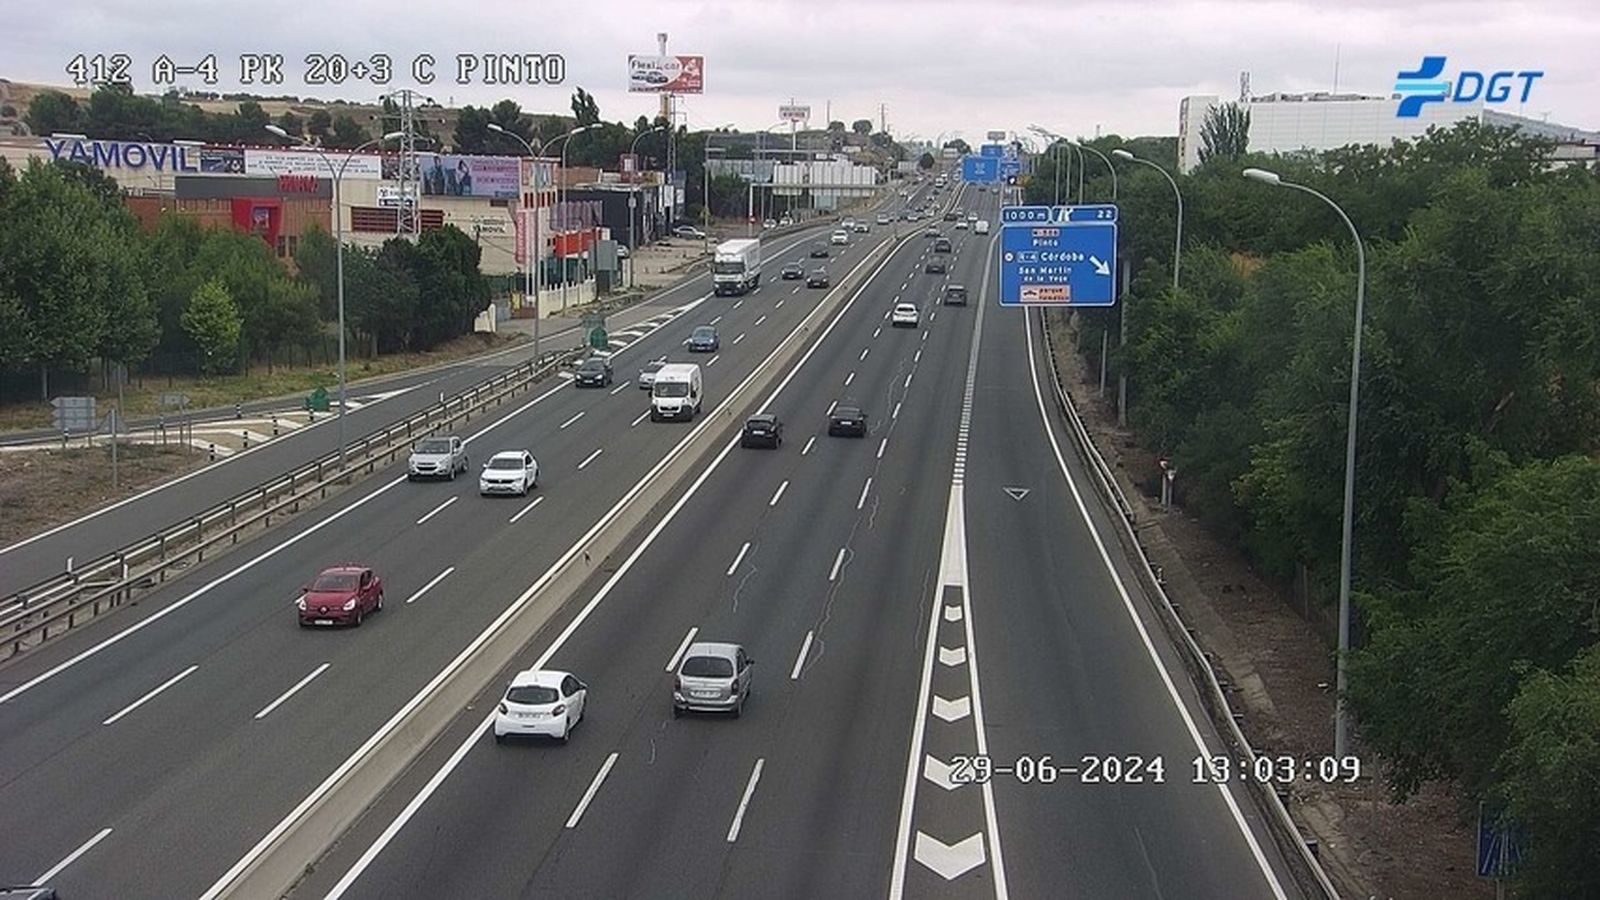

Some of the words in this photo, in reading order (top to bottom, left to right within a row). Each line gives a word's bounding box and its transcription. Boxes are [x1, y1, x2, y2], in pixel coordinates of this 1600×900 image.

[45, 139, 199, 173] YAMOVIL
[1005, 211, 1035, 220] 1000
[1097, 210, 1113, 218] 22
[1032, 238, 1059, 247] Pinto
[1018, 266, 1036, 275] San
